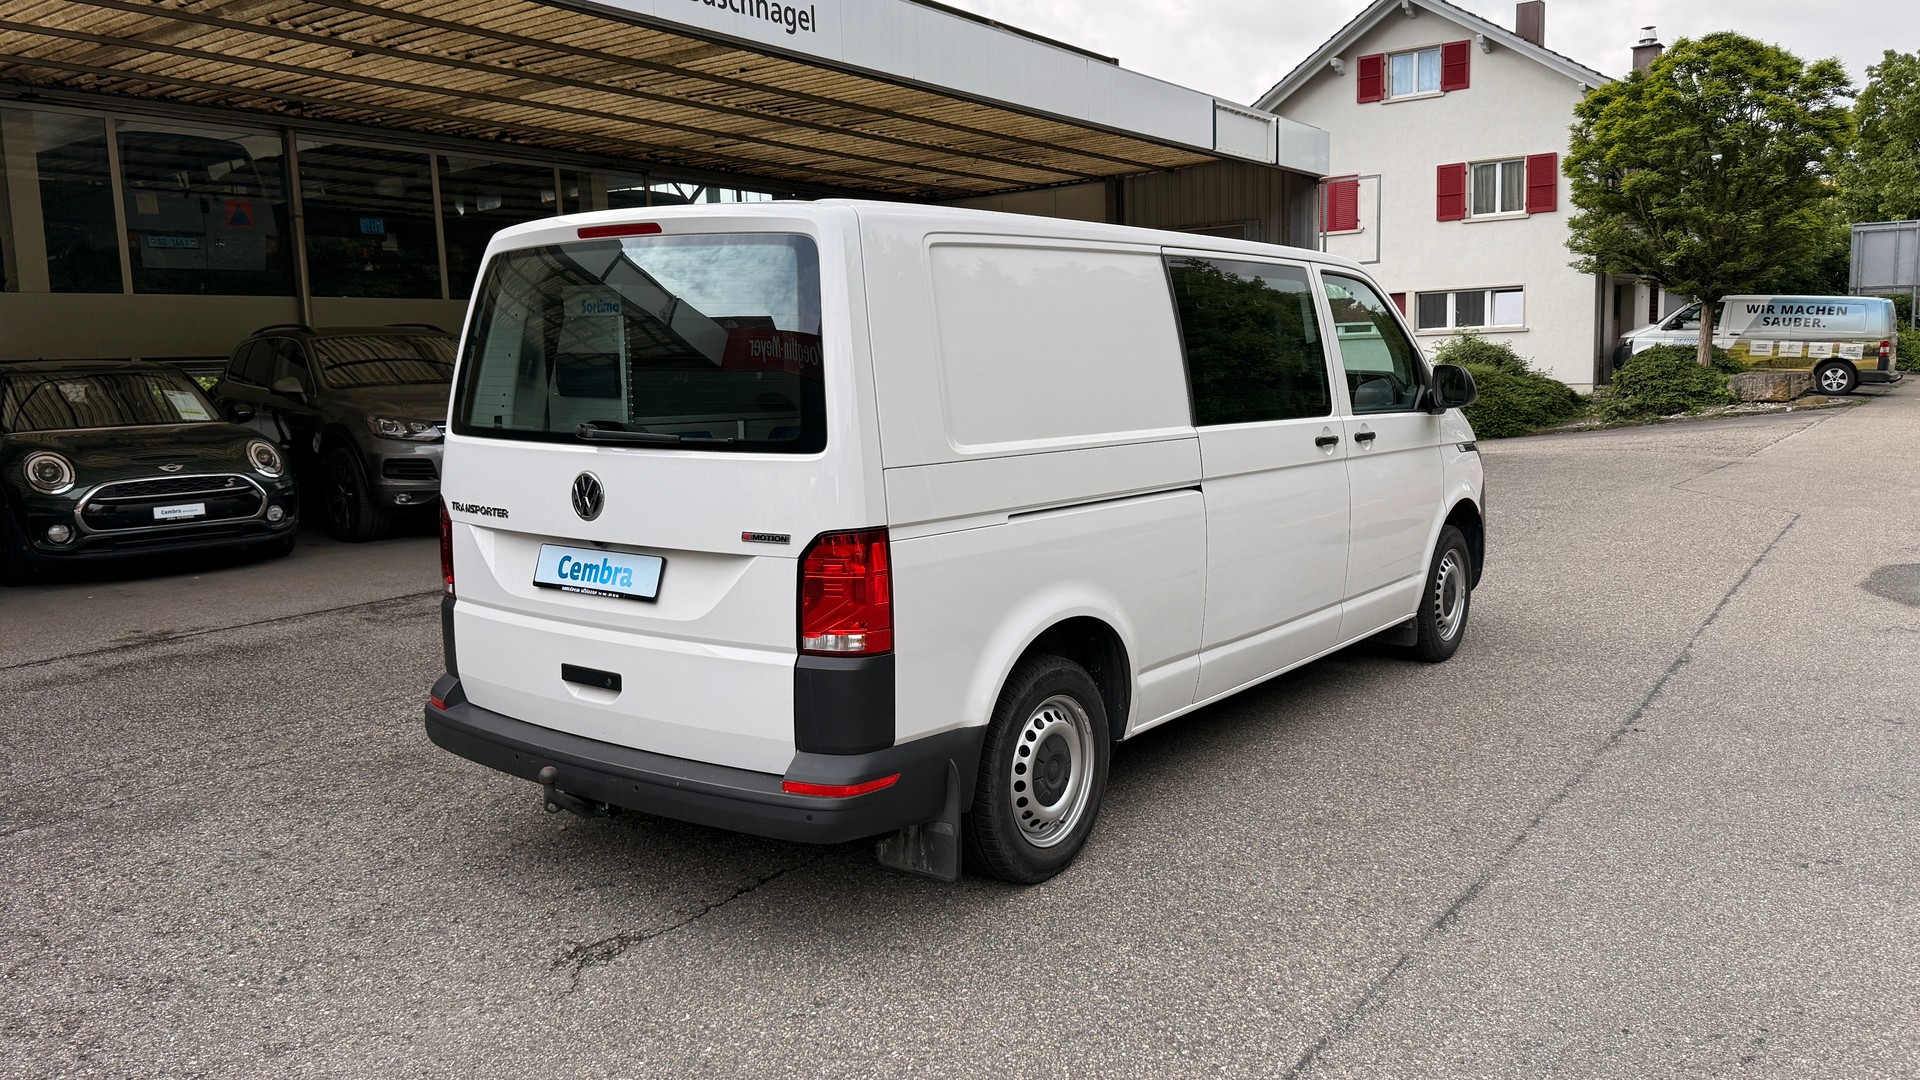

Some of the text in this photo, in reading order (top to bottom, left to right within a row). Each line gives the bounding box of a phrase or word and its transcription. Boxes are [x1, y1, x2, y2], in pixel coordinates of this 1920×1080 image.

[581, 299, 620, 314] Sortimo
[1746, 304, 1848, 316] WIR MACHEN
[1762, 316, 1826, 328] SAUBER.
[451, 501, 509, 519] TRANSPORTER
[557, 555, 633, 588] Cembra
